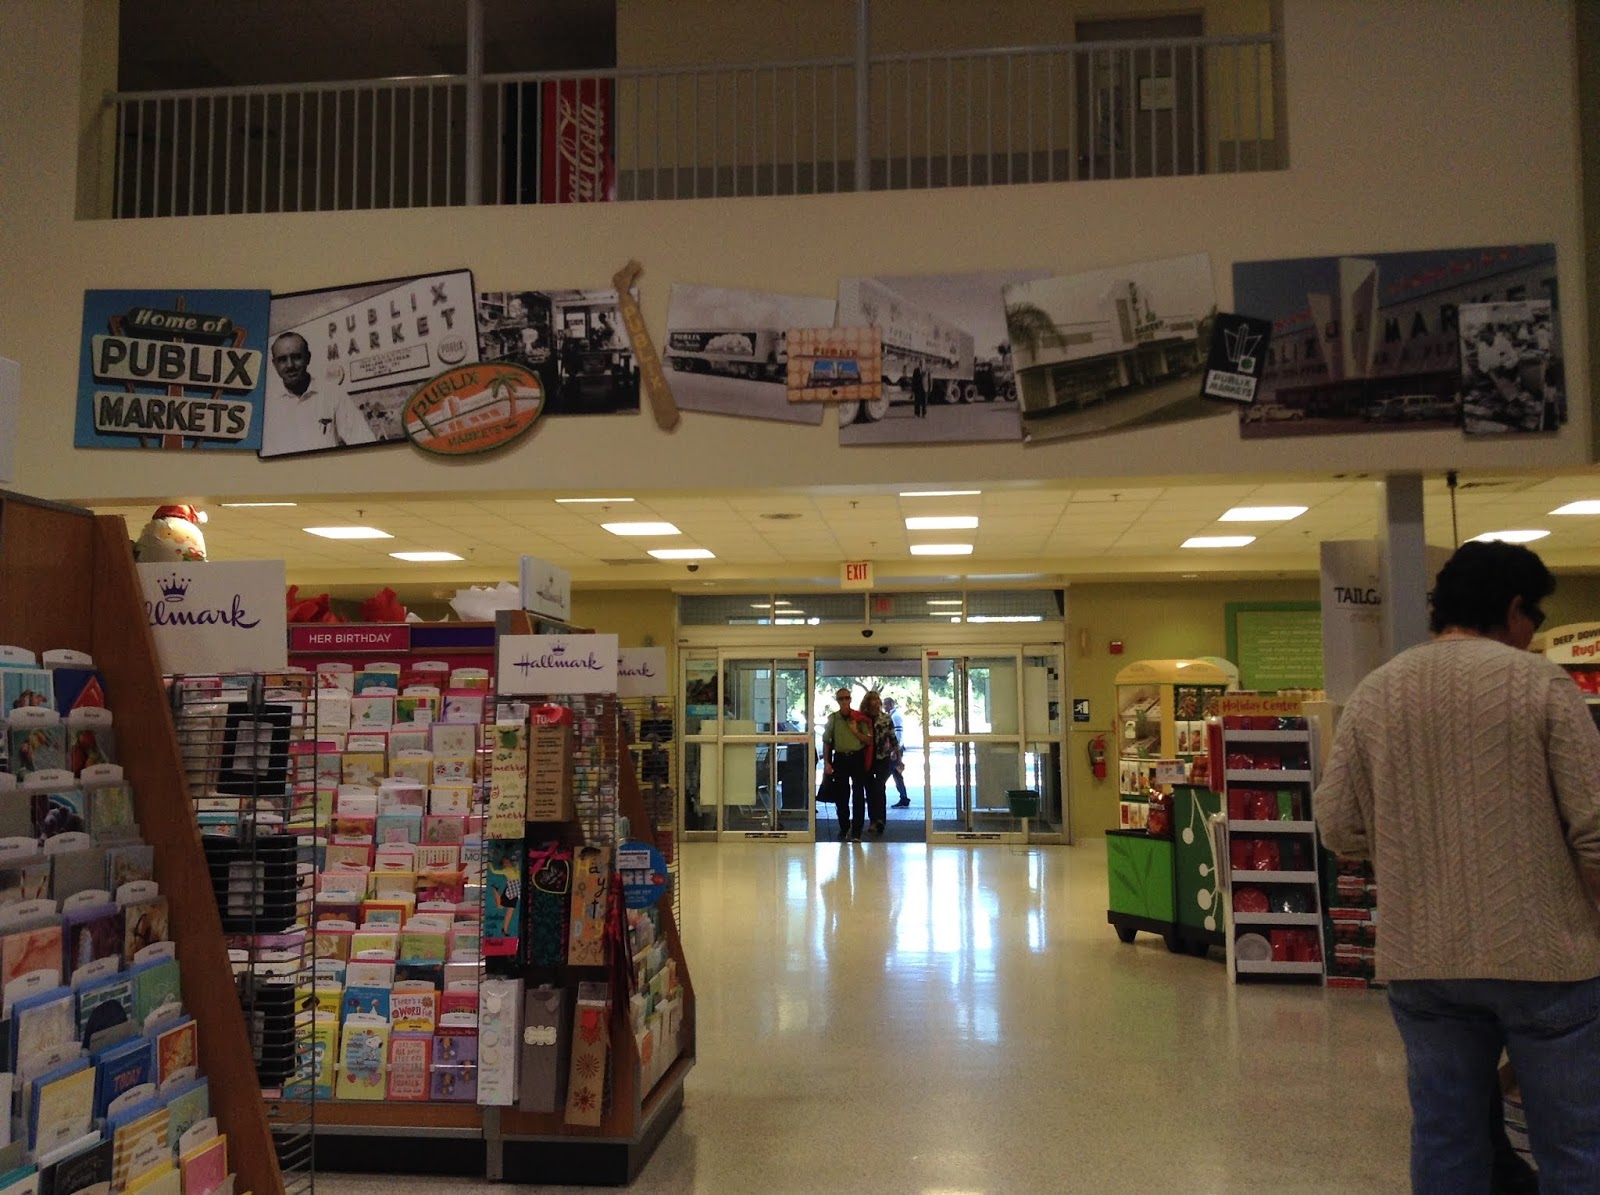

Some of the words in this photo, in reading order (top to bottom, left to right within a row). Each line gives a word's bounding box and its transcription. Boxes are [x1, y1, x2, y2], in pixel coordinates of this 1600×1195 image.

[327, 282, 449, 339] PUBLIX
[134, 309, 198, 330] Home
[202, 317, 228, 334] of
[327, 307, 457, 361] MARKET
[99, 338, 254, 388] PUBLIX
[1209, 382, 1254, 398] MARKETS
[1214, 374, 1251, 388] PUBLIX
[98, 395, 248, 434] MARKETS
[413, 373, 480, 438] PUBLIX
[846, 563, 868, 581] EXIT
[143, 594, 261, 629] llmark
[308, 633, 333, 645] HER
[335, 633, 392, 645] BIRTHDAY
[1553, 634, 1575, 647] DEEP
[513, 652, 604, 677] Hallmark
[1222, 699, 1260, 713] Holiday
[1263, 699, 1299, 713] Center
[391, 997, 417, 1008] There's
[398, 1006, 421, 1018] WORD
